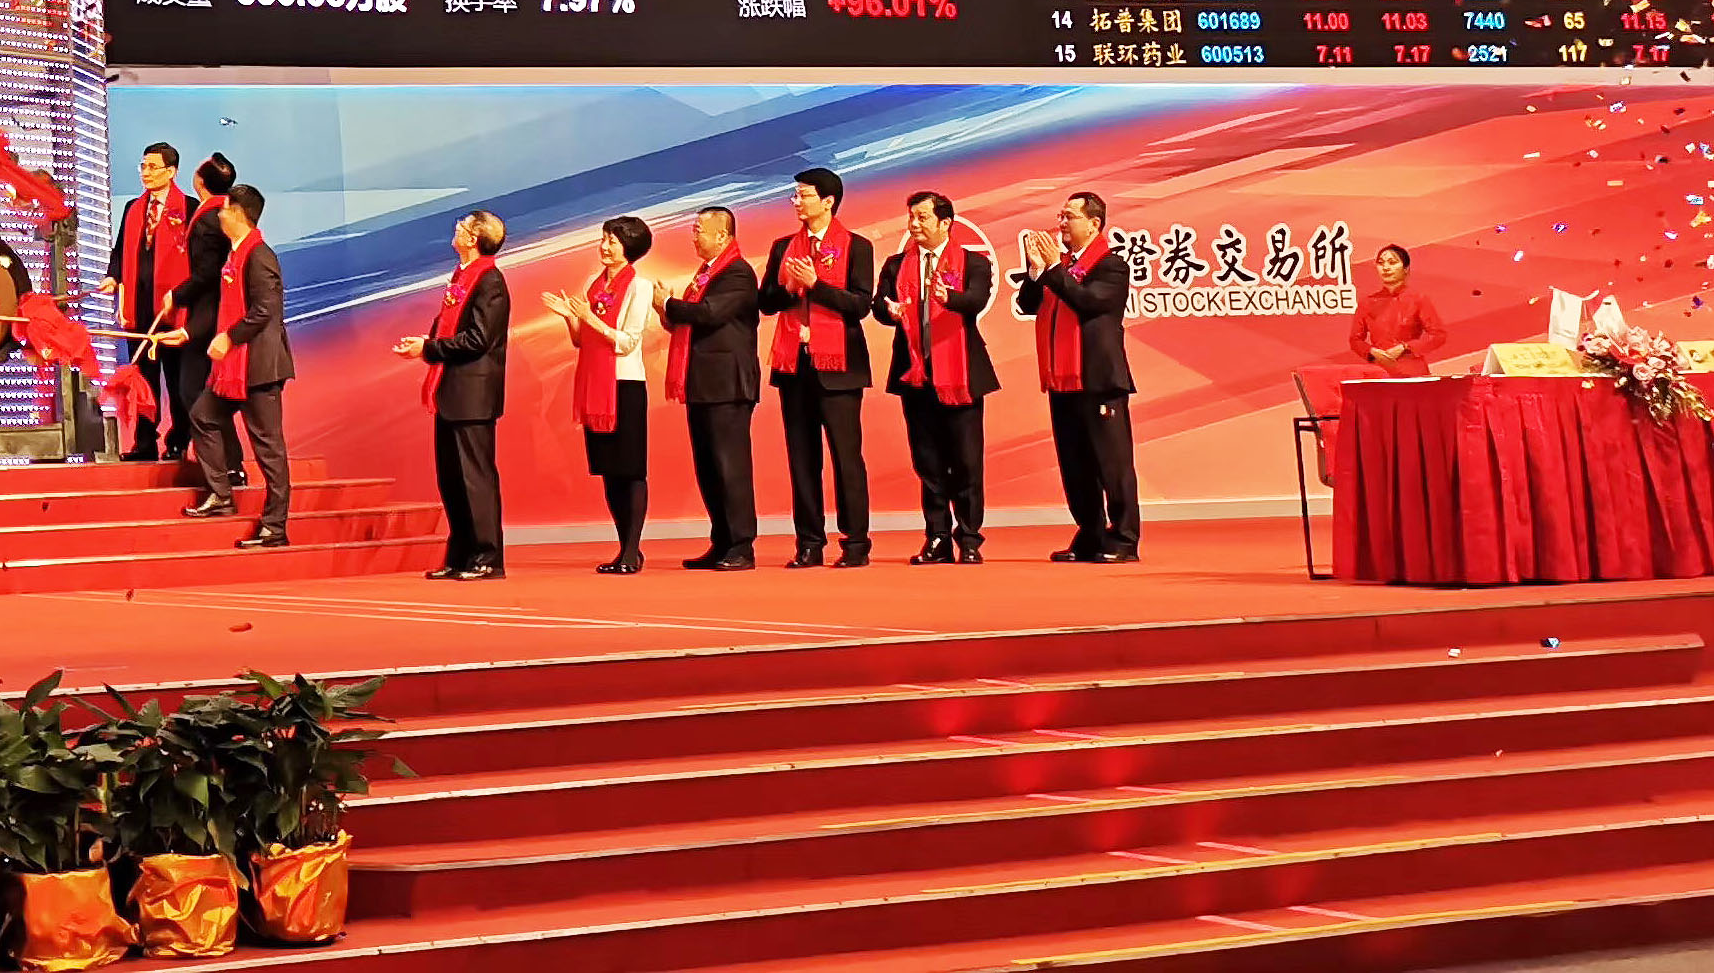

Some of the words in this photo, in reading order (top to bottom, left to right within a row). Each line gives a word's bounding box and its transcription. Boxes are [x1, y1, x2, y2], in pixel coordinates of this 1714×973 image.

[1052, 12, 1073, 28] 14
[1089, 8, 1182, 33] 拓普集团
[1198, 13, 1260, 30] 601689
[1304, 12, 1349, 30] 11.00
[1382, 13, 1427, 30] 11.03
[1464, 13, 1505, 29] 7440
[1564, 13, 1584, 29] 65
[1055, 45, 1076, 62] 15
[1093, 42, 1187, 66] 联环药业
[1201, 47, 1264, 64] 600513
[1317, 45, 1352, 63] 7.11
[1394, 46, 1431, 63] 7.17
[1559, 45, 1587, 62] 117
[1010, 226, 1349, 286] 證券交易所
[1143, 291, 1220, 313] STOCK
[1229, 289, 1354, 311] EXCHANGE
